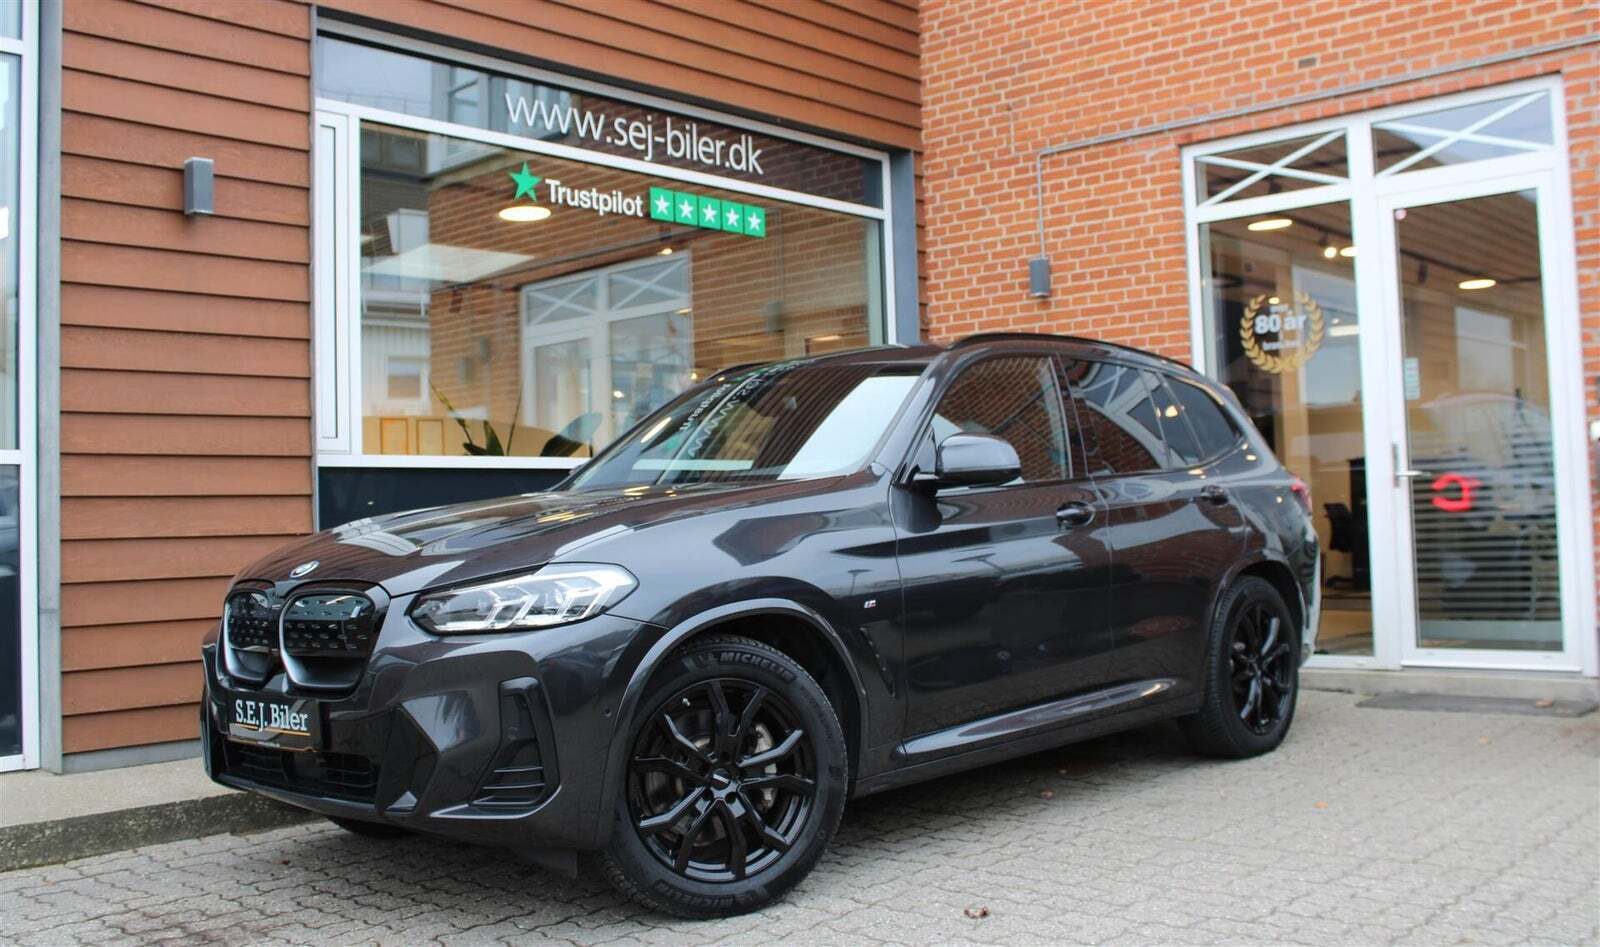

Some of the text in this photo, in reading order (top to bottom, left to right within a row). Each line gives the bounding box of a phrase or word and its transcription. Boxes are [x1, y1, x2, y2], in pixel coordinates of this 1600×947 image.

[505, 93, 764, 175] www.sej-biler.dk
[545, 178, 644, 217] Trustpilot
[1254, 314, 1281, 335] 80
[719, 651, 798, 683] MICHELIN
[235, 699, 309, 732] S.E.J. Biler
